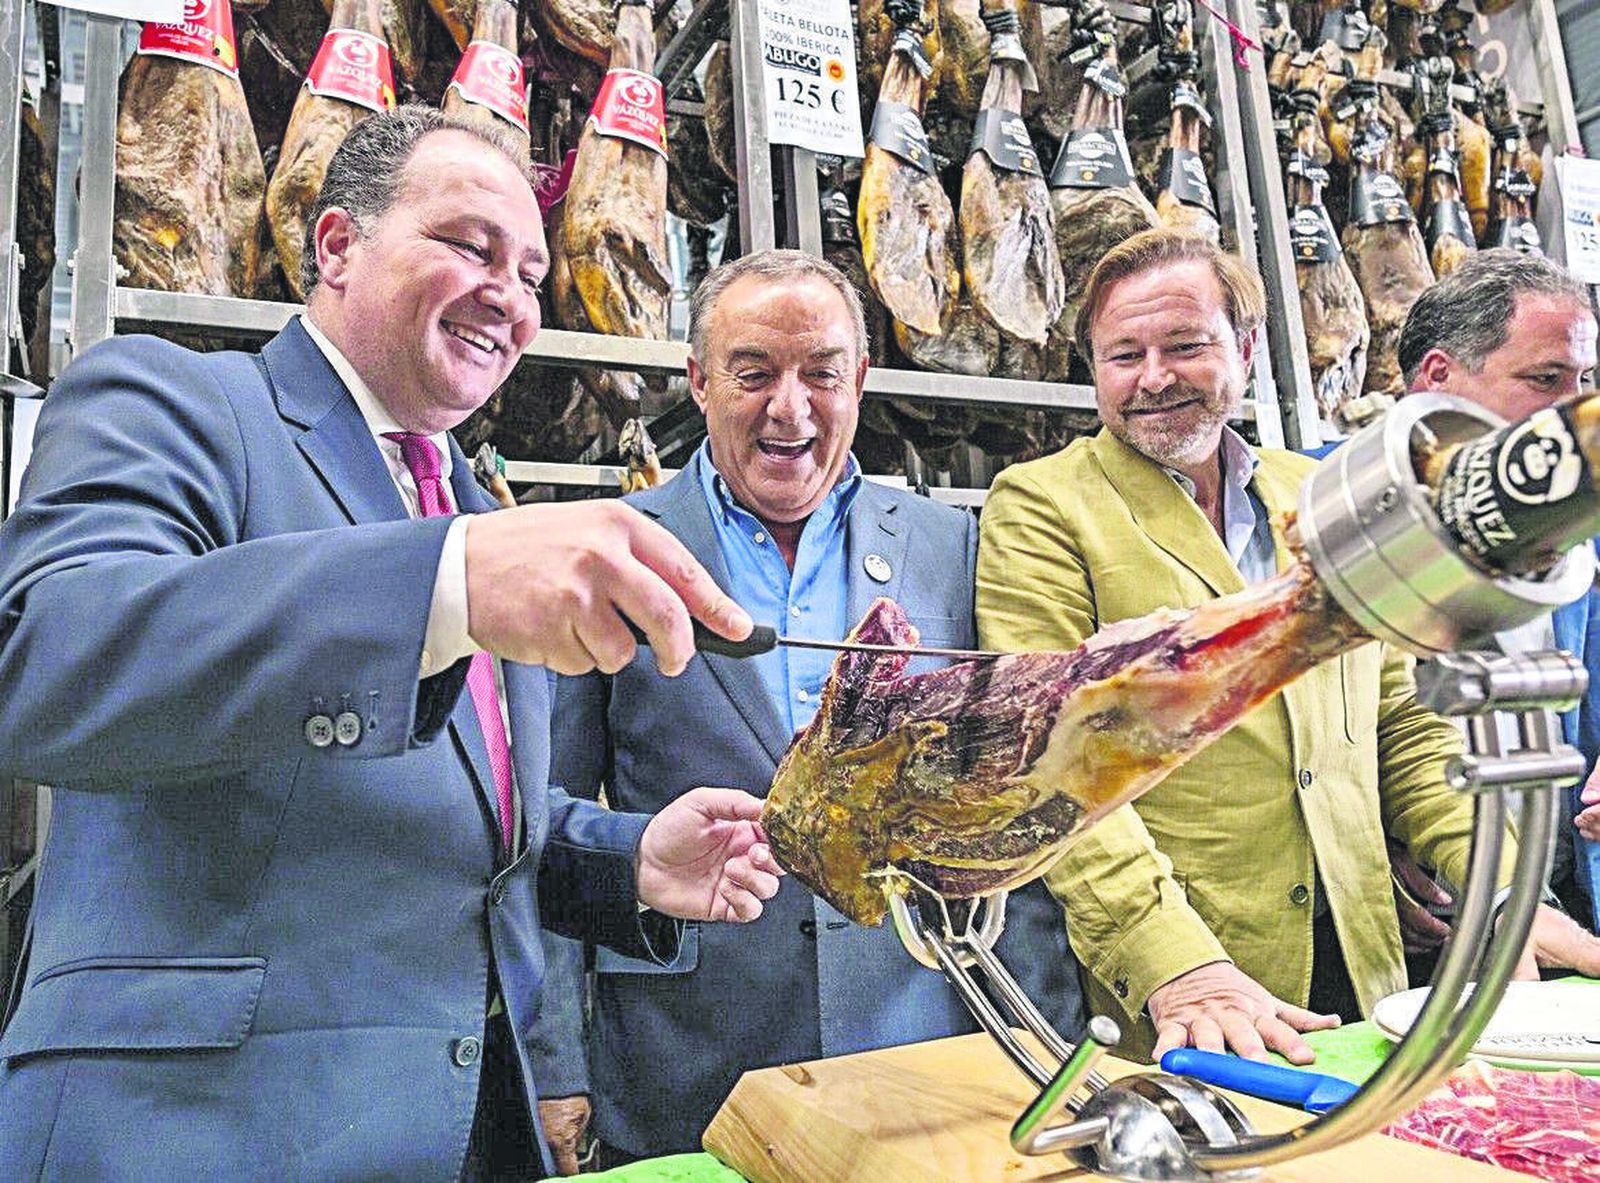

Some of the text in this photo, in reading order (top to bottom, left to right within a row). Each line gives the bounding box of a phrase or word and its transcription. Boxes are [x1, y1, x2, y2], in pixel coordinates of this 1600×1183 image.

[798, 18, 849, 40] BELLOTA
[764, 43, 821, 71] ABUGO
[796, 36, 842, 57] IBERICA
[777, 78, 846, 115] 125 €
